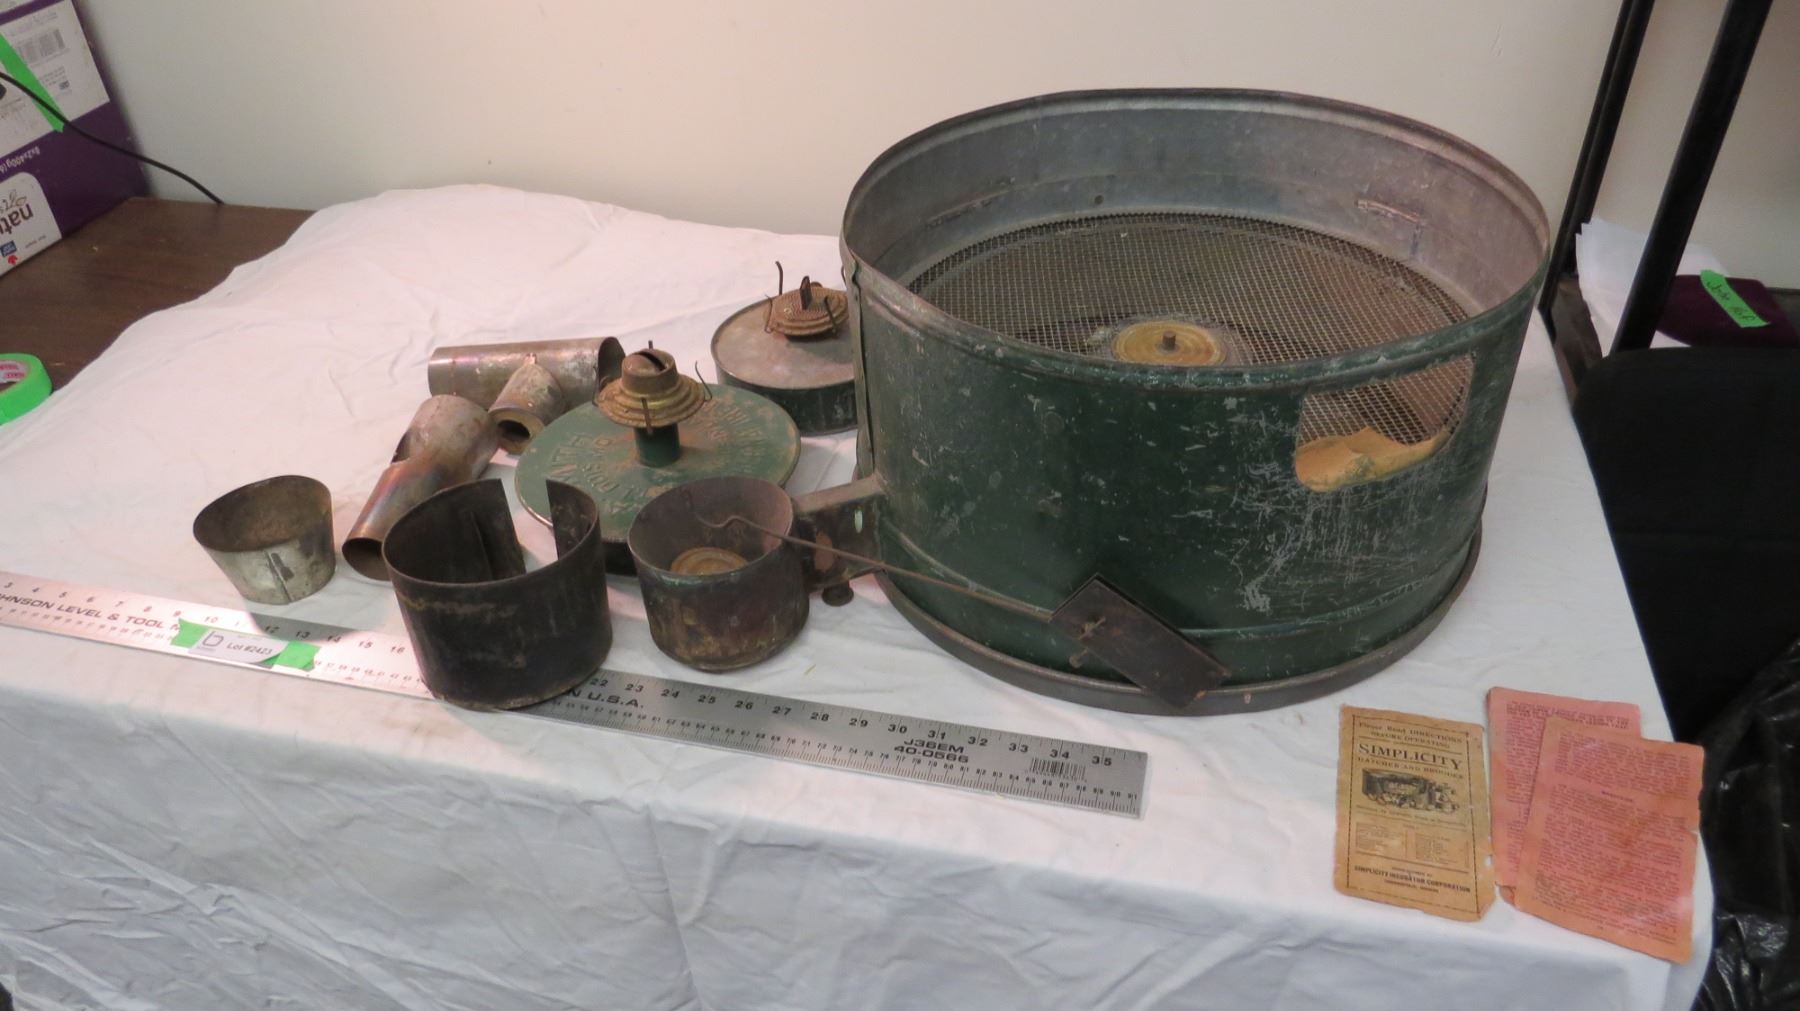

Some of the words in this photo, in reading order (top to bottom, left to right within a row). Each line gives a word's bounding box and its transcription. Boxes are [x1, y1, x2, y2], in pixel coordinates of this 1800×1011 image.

[0, 593, 55, 609] HNSON
[57, 604, 102, 618] LEVEL
[126, 616, 164, 628] TOOL
[226, 642, 244, 650] Lot
[264, 625, 279, 634] 12
[296, 631, 310, 639] 13
[391, 646, 405, 654] 16
[590, 678, 608, 688] 22
[624, 683, 644, 693] 23
[661, 689, 680, 698] 24
[697, 694, 716, 704] 25
[734, 700, 753, 710] 26
[772, 706, 792, 716] 27
[810, 712, 830, 721] 28
[849, 718, 869, 728] 29
[888, 724, 908, 734] 30
[928, 730, 946, 740] 31
[967, 736, 988, 746] 32
[1008, 742, 1029, 753] 33
[1050, 749, 1069, 759] 34
[1092, 755, 1112, 766] 35
[588, 692, 644, 709] U.S.A.
[904, 739, 964, 753] J36EM
[1359, 743, 1462, 770] SIMPLICITY
[1354, 865, 1388, 877] SIMPLICITY
